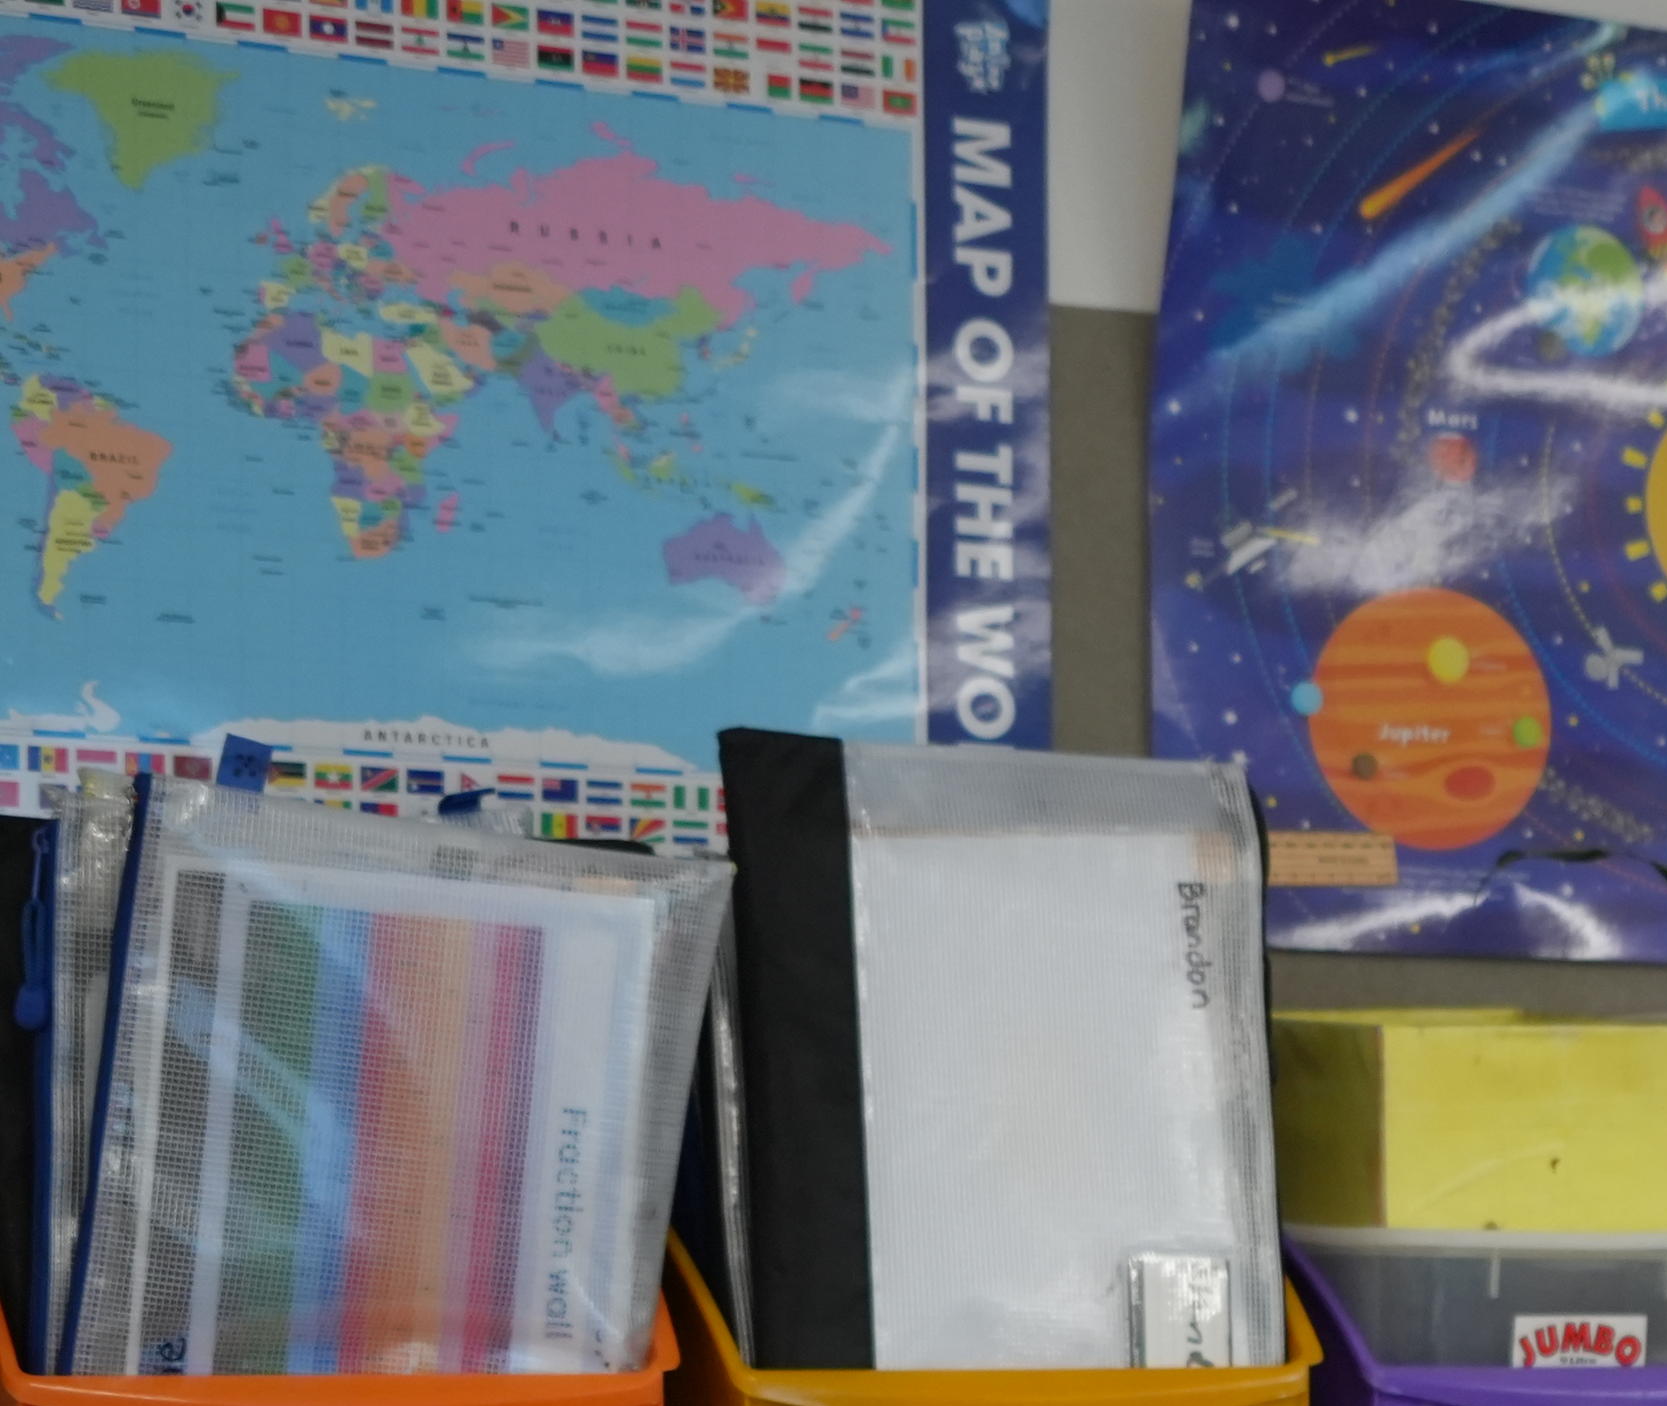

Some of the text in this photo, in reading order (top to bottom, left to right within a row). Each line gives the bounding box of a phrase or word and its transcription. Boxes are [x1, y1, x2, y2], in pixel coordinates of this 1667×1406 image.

[952, 117, 1013, 298] MAP
[953, 318, 1015, 425] OF
[1428, 410, 1479, 431] Mars
[954, 448, 1015, 581] THE
[955, 603, 1016, 749] WO
[363, 729, 491, 750] ANTARCTICA
[1378, 724, 1451, 746] Jupiter
[1177, 883, 1211, 1011] Brandon
[545, 1107, 588, 1339] Fraction wall
[1518, 1322, 1643, 1368] JUMBO
